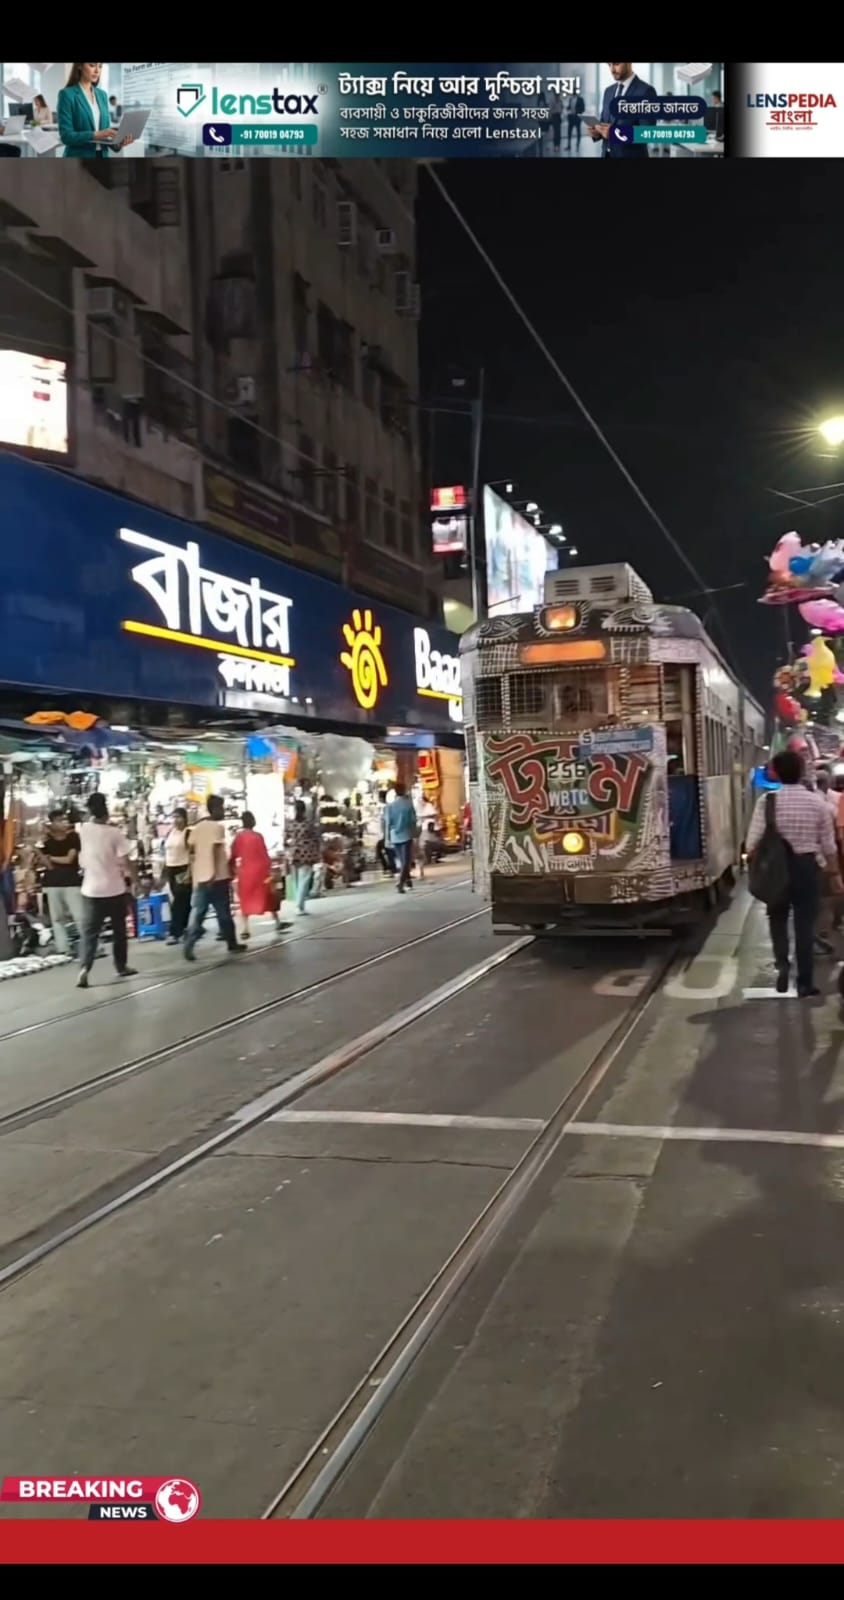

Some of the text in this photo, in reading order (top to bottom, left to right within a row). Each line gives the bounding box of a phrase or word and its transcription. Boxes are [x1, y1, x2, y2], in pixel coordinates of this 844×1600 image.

[119, 527, 293, 654] বাজার
[548, 764, 587, 778] 256
[549, 789, 588, 807] WBTC
